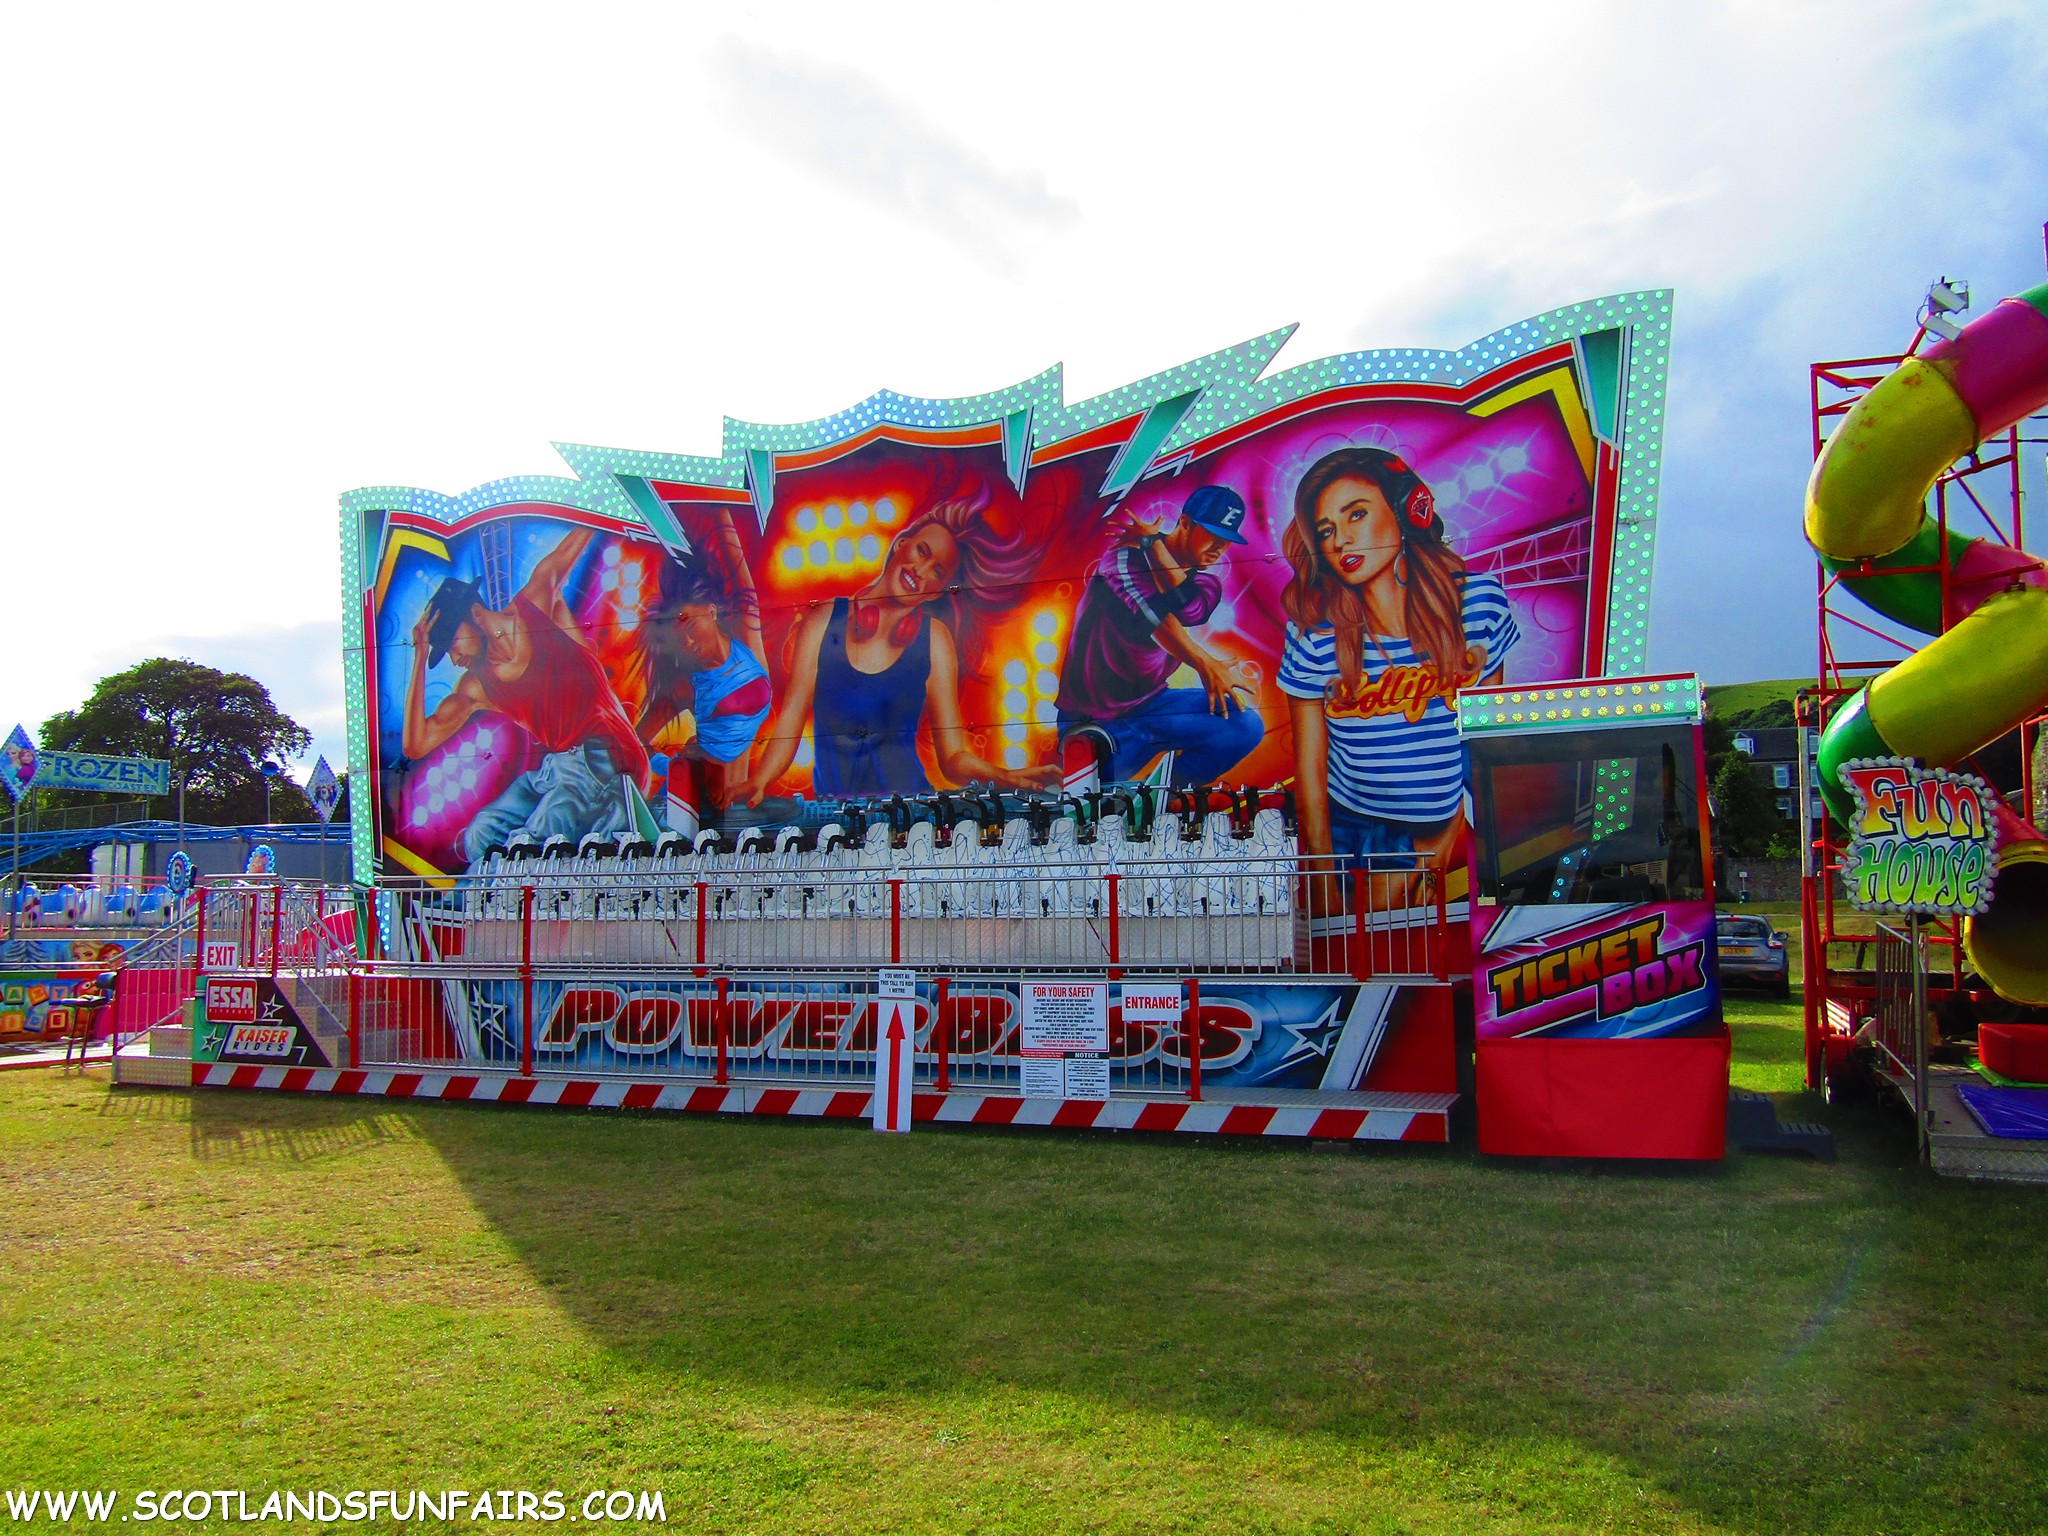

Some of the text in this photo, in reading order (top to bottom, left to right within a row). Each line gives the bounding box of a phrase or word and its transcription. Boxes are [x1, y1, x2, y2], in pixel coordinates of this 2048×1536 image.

[1327, 666, 1477, 721] Lollip
[107, 782, 159, 793] COASTER
[1849, 768, 1987, 841] Fun
[1852, 841, 1985, 907] House
[207, 946, 236, 966] EXIT
[1492, 918, 1662, 1013] TICKET
[1033, 987, 1095, 998] FOR YOUR SAFETY
[1602, 947, 1701, 1015] BOX
[209, 986, 254, 1009] ESSA
[1125, 996, 1179, 1009] ENTRANCE
[236, 1028, 290, 1044] KAISER
[534, 983, 1262, 1069] POWERBS
[232, 1042, 285, 1052] RIDES
